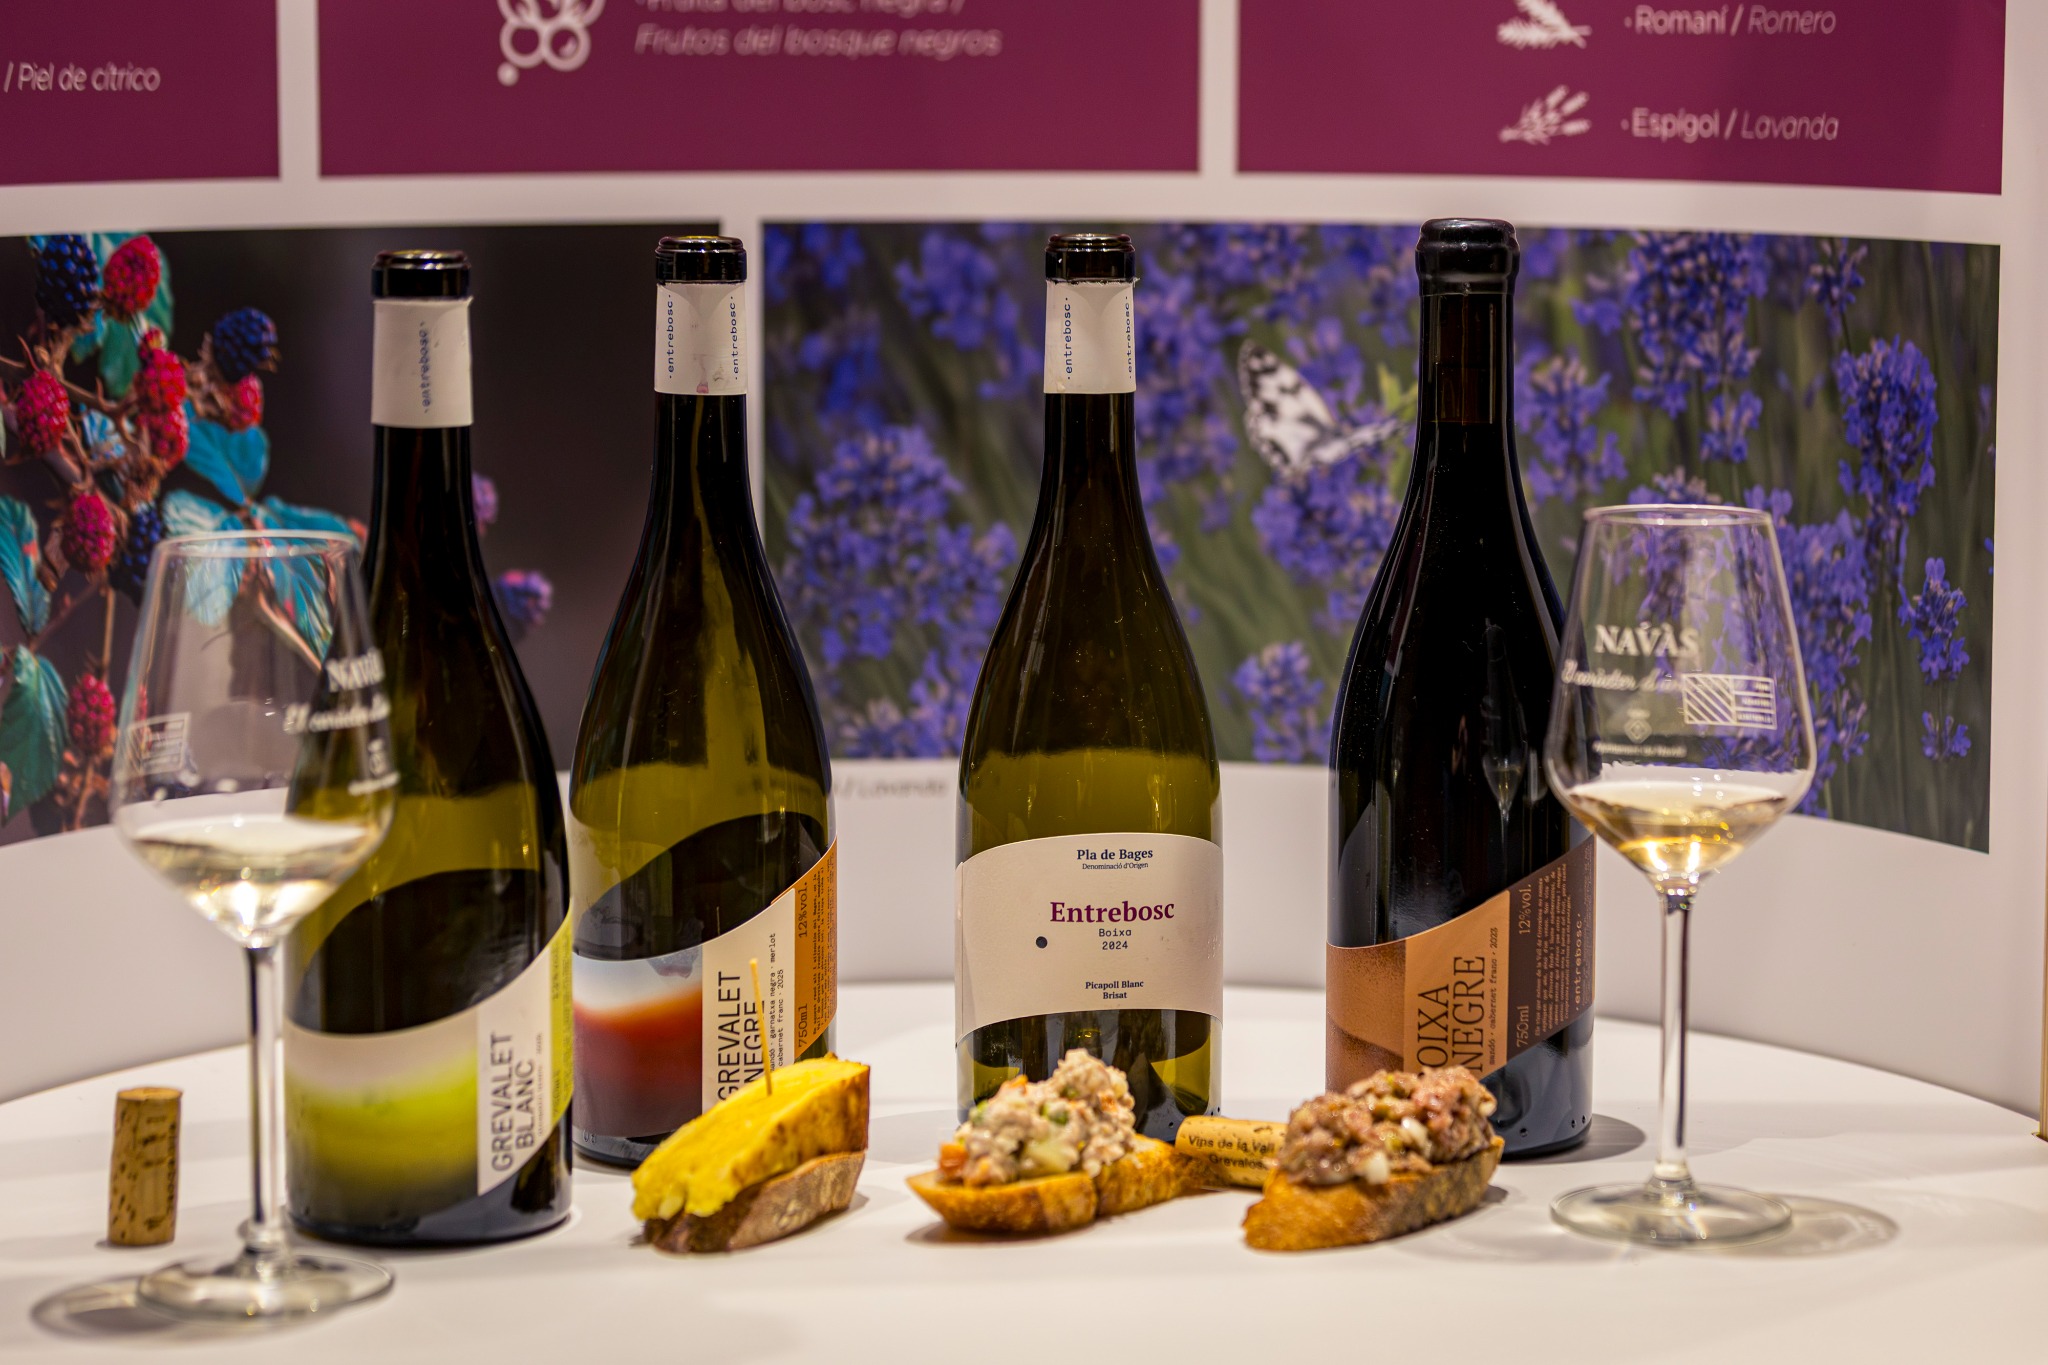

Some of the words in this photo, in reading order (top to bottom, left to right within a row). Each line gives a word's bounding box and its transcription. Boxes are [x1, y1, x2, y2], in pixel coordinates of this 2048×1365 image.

[1748, 5, 1836, 35] Romero
[634, 23, 731, 56] Frutos
[734, 23, 784, 56] del
[784, 24, 898, 60] bosque
[898, 29, 1003, 62] negros
[18, 61, 55, 91] Piel
[58, 62, 88, 91] de
[1741, 110, 1838, 141] Lavanda
[1077, 849, 1097, 860] Pla
[1101, 849, 1115, 860] de
[1119, 849, 1153, 862] Bages
[1082, 862, 1123, 870] Denominació
[1123, 862, 1149, 870] d'Origen
[797, 881, 809, 938] 12%vol.
[1050, 901, 1175, 923] Entrebosc
[1517, 883, 1532, 935] 12%vol.
[768, 933, 776, 963] merlot
[1098, 928, 1132, 938] Boixa
[1102, 940, 1128, 951] 2024
[770, 972, 778, 997] negra
[1085, 981, 1119, 991] Picapoll
[1121, 980, 1144, 989] Blanc
[1488, 958, 1498, 985] franc
[1102, 991, 1128, 1000] Brisat
[1488, 988, 1498, 1030] cabernet
[769, 1000, 777, 1039] garnatxa
[797, 1003, 809, 1048] 750ml
[1416, 984, 1449, 1072] OIXA
[1452, 956, 1485, 1073] NEGRE
[1516, 1005, 1530, 1049] 750ml
[717, 971, 741, 1101] GREVALET
[744, 1000, 765, 1084] NEGRE
[489, 1032, 514, 1172] GREVALET
[515, 1059, 535, 1150] BLANC
[1217, 1138, 1233, 1150] de
[1208, 1154, 1268, 1170] Grevalos
